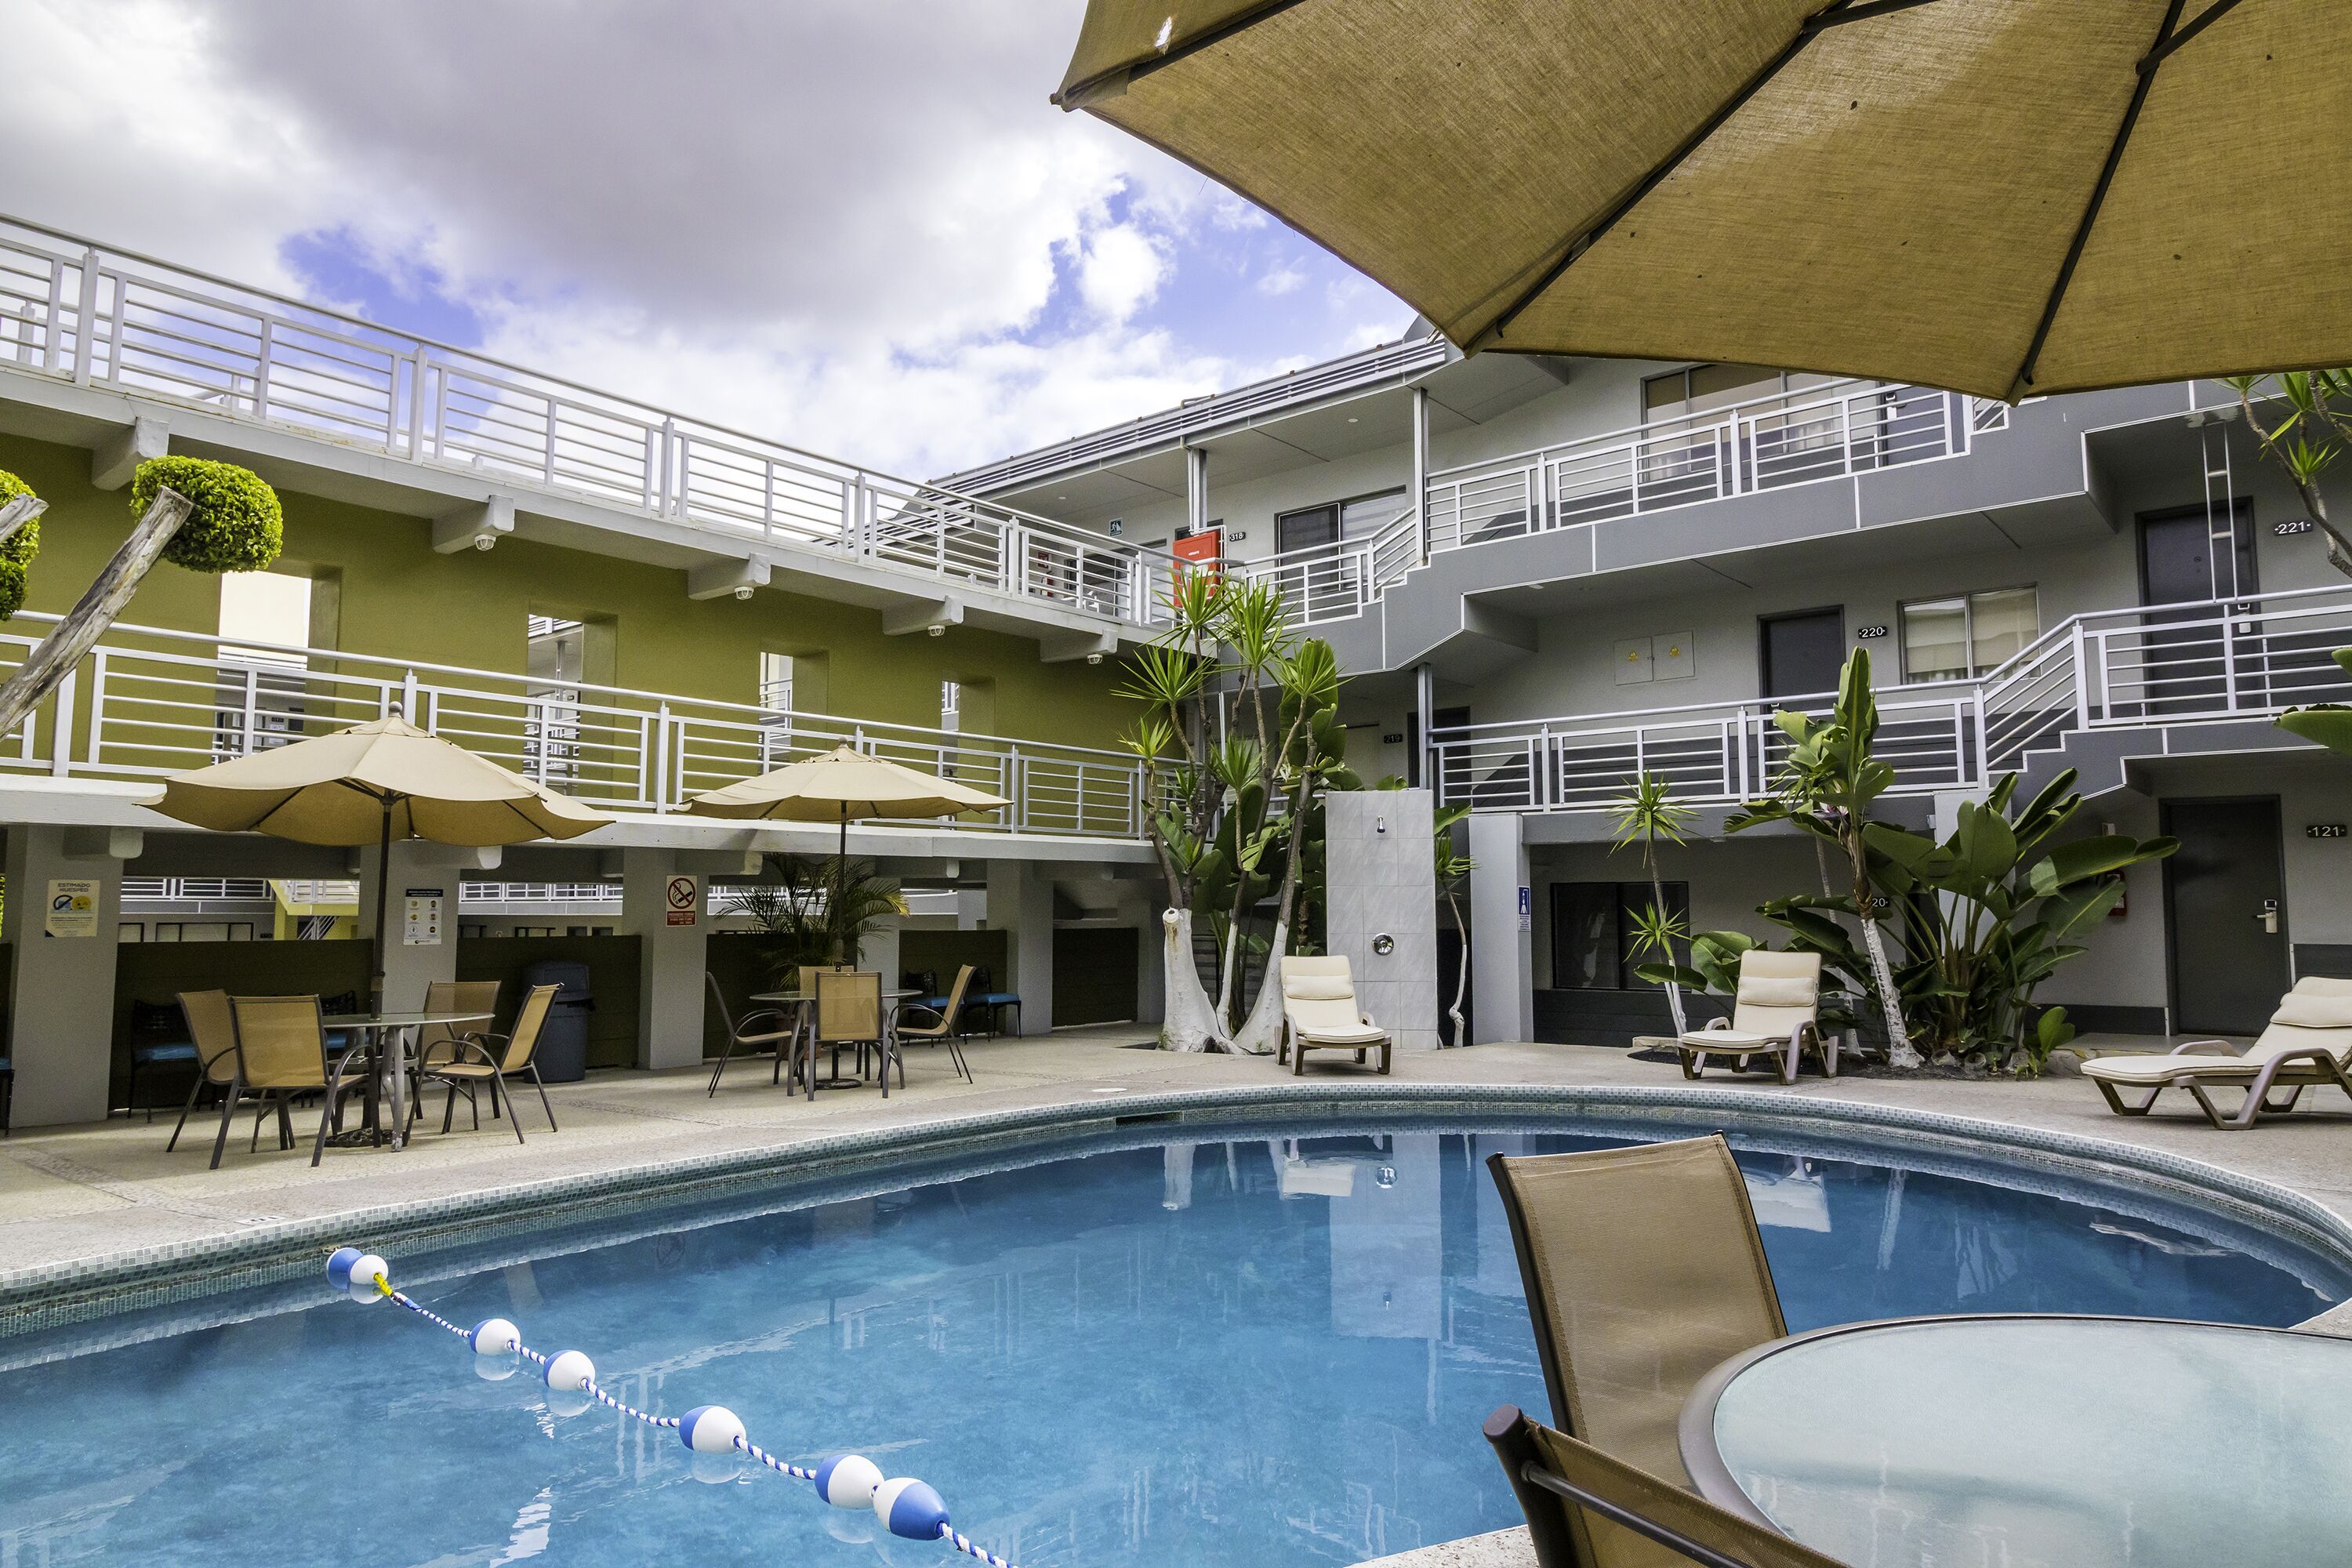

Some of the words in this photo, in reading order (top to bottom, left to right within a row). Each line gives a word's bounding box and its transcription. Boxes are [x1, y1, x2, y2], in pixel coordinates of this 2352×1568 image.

[2278, 521, 2304, 534] 221
[1861, 626, 1883, 638] 220
[2312, 826, 2339, 837] 121
